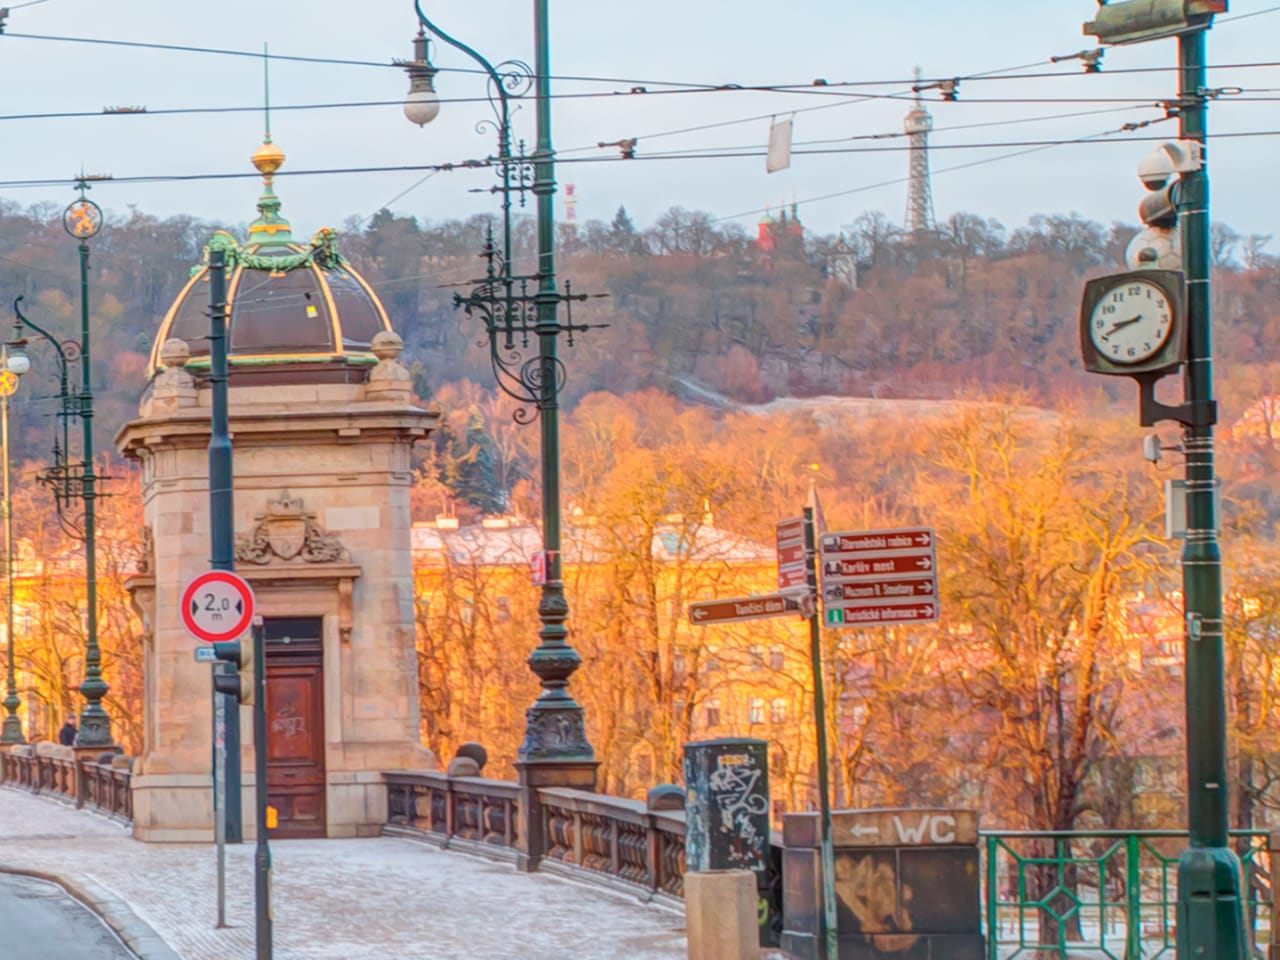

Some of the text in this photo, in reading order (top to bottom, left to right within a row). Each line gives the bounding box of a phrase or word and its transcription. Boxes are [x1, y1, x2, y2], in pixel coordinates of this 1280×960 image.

[1128, 286, 1140, 296] 12
[1146, 289, 1151, 299] 1
[1113, 292, 1124, 302] 11
[1156, 299, 1164, 308] 2
[1102, 305, 1116, 315] 10
[1160, 313, 1168, 323] 3
[1096, 320, 1104, 329] 9
[1112, 344, 1119, 354] 7
[1127, 347, 1135, 356] 6
[873, 560, 895, 572] most
[204, 593, 230, 611] 2.0
[212, 613, 223, 621] m
[893, 815, 956, 843] WC
